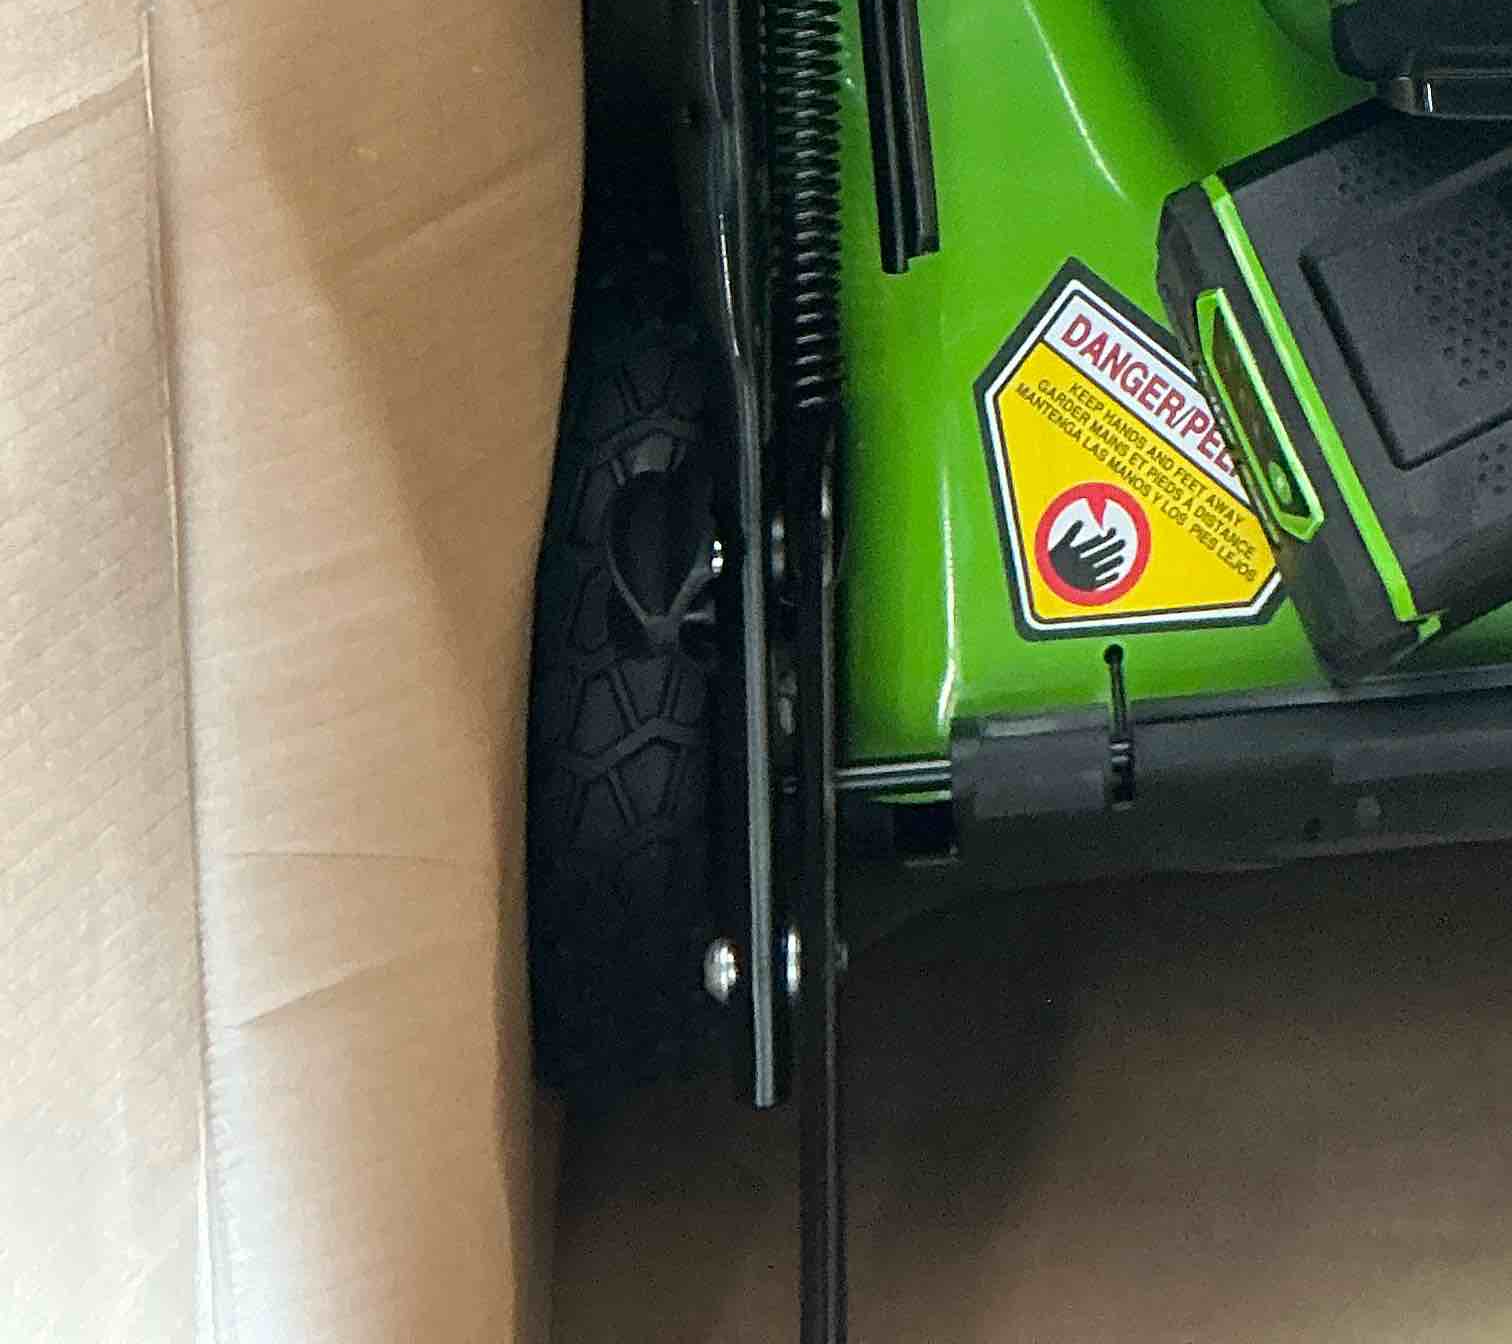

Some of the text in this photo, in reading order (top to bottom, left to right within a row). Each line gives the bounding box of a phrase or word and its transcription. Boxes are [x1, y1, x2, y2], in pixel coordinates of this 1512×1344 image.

[1016, 382, 1257, 583] MANTENGA LAS MANOS Y LOS PIES LEJOS
[1038, 378, 1091, 426] GARDER
[1089, 419, 1131, 458] MAINS
[1128, 452, 1150, 471] ET
[1147, 466, 1184, 501] PIEDS
[1194, 505, 1257, 560] DISTANCE
[1069, 382, 1246, 527] KEEP HANDS AND FEET AWAY
